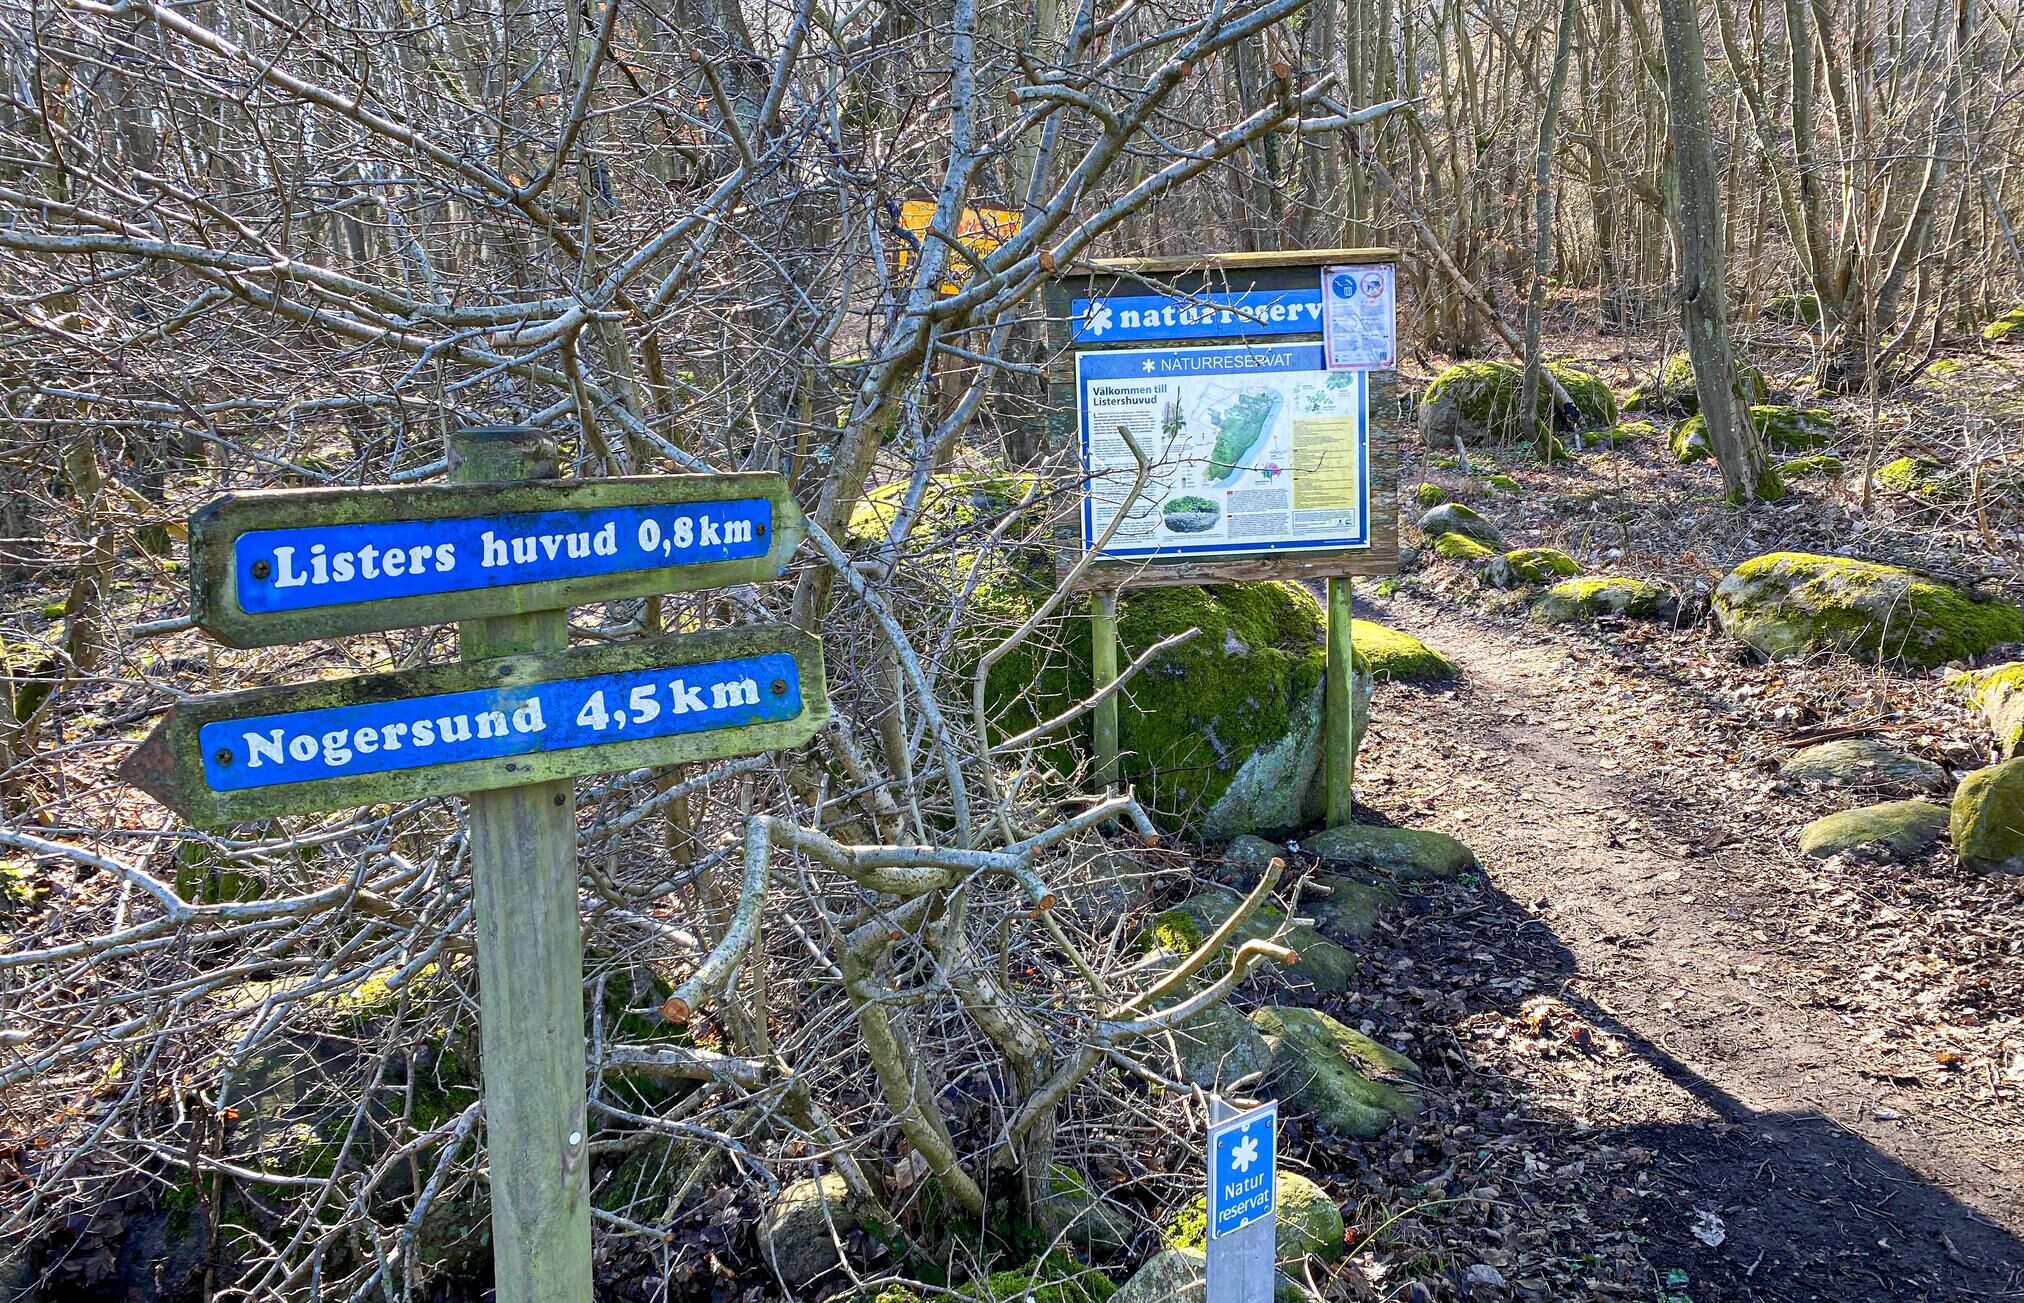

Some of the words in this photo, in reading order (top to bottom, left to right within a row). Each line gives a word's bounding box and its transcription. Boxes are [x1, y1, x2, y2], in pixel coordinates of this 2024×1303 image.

[1160, 353, 1293, 371] NATURRESERVAT
[1093, 386, 1152, 396] Välkommen
[1154, 384, 1167, 393] till
[1093, 395, 1157, 406] Listershuvud
[273, 543, 456, 589] Listers
[481, 522, 618, 568] huvud
[242, 696, 546, 768] Nogersund
[1225, 1172, 1264, 1201] Natur
[1218, 1189, 1269, 1223] reservat
